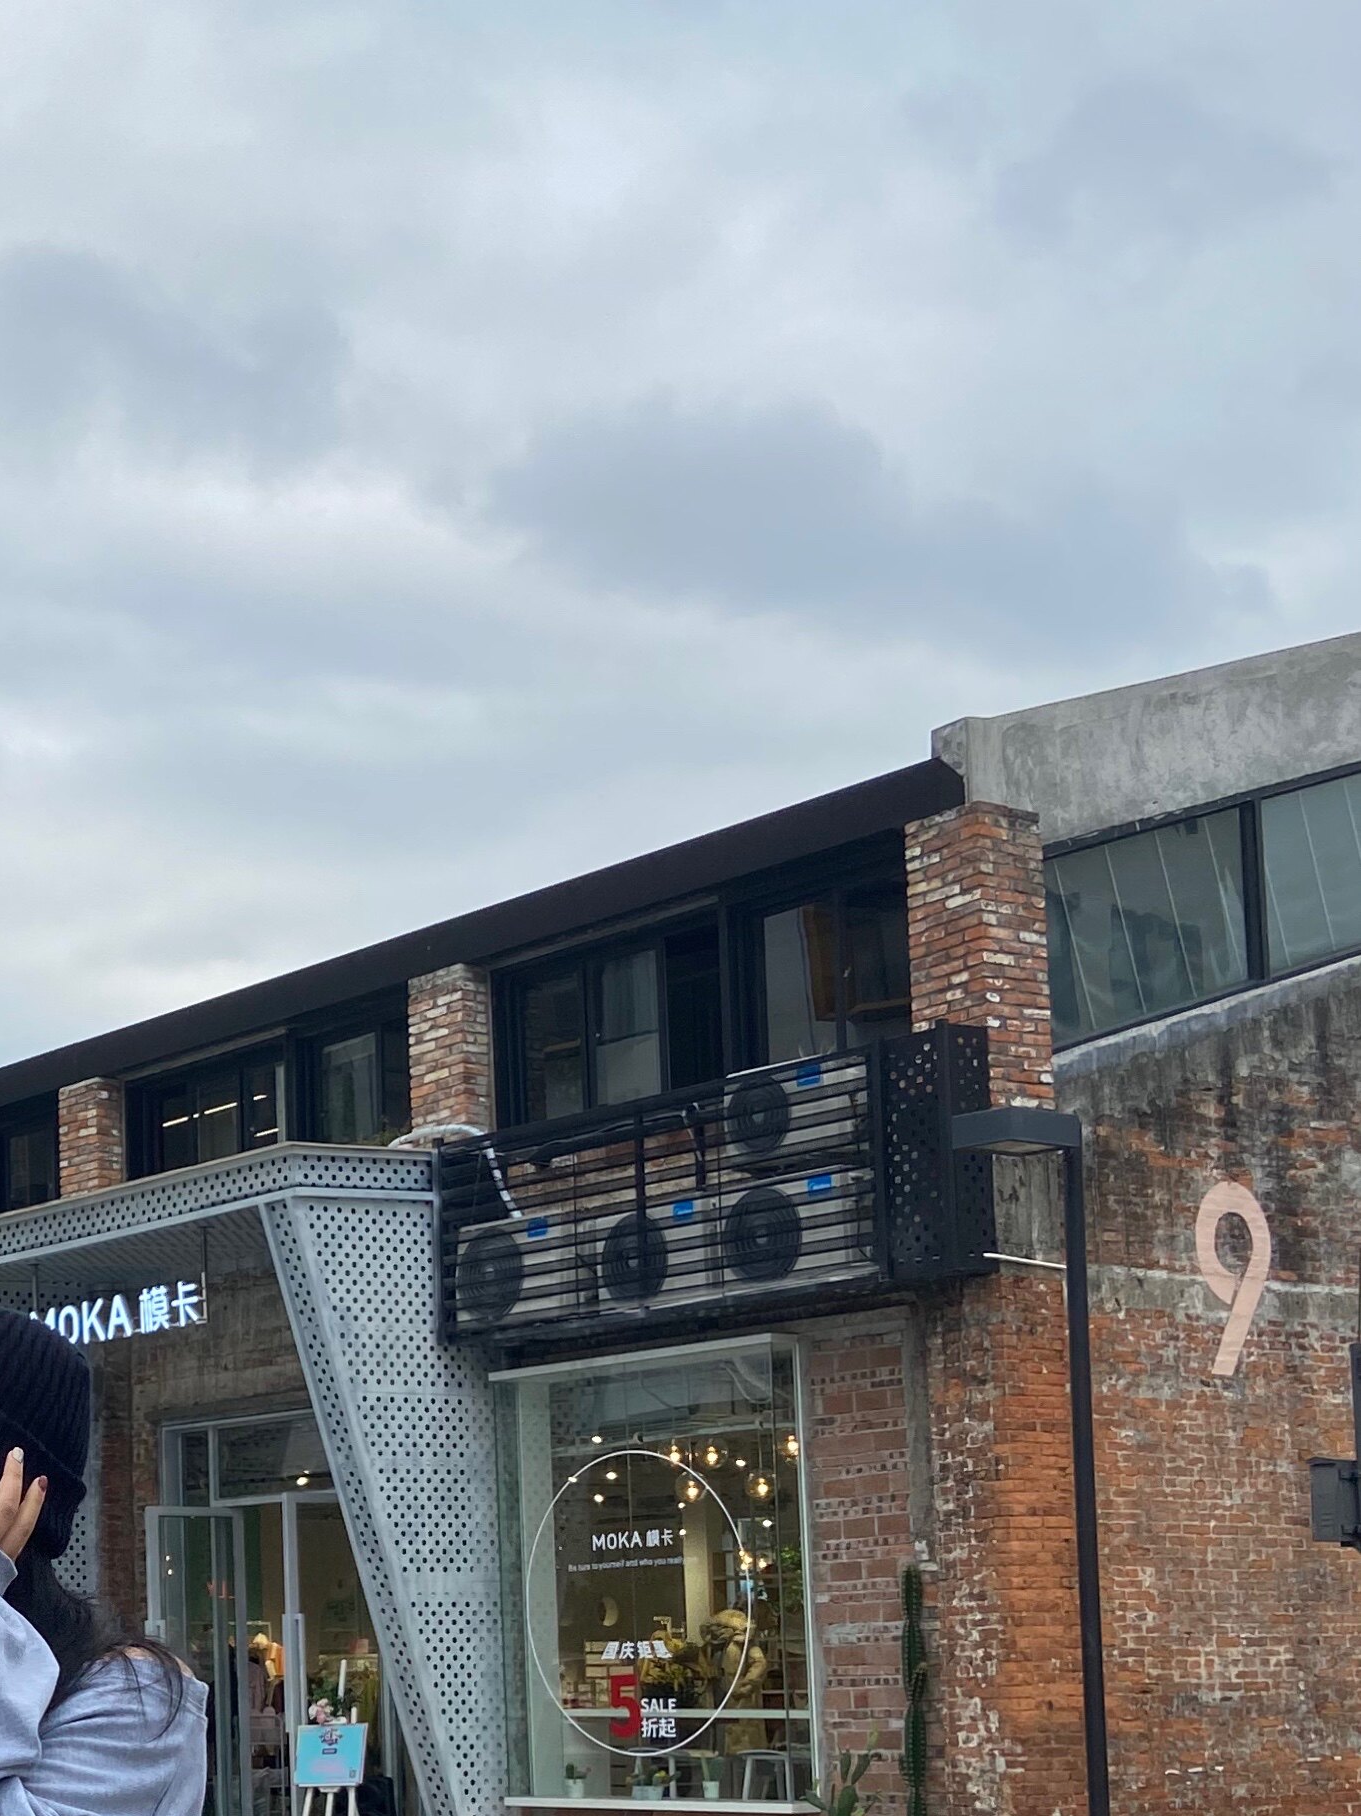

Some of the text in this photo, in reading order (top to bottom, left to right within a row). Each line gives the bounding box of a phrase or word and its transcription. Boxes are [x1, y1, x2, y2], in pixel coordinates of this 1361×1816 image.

[1195, 1180, 1272, 1376] 9
[138, 1280, 200, 1335] 模卡
[591, 1530, 644, 1552] MOKA
[609, 1674, 640, 1738] 5
[640, 1697, 677, 1713] SALE
[640, 1717, 677, 1738] 折起
